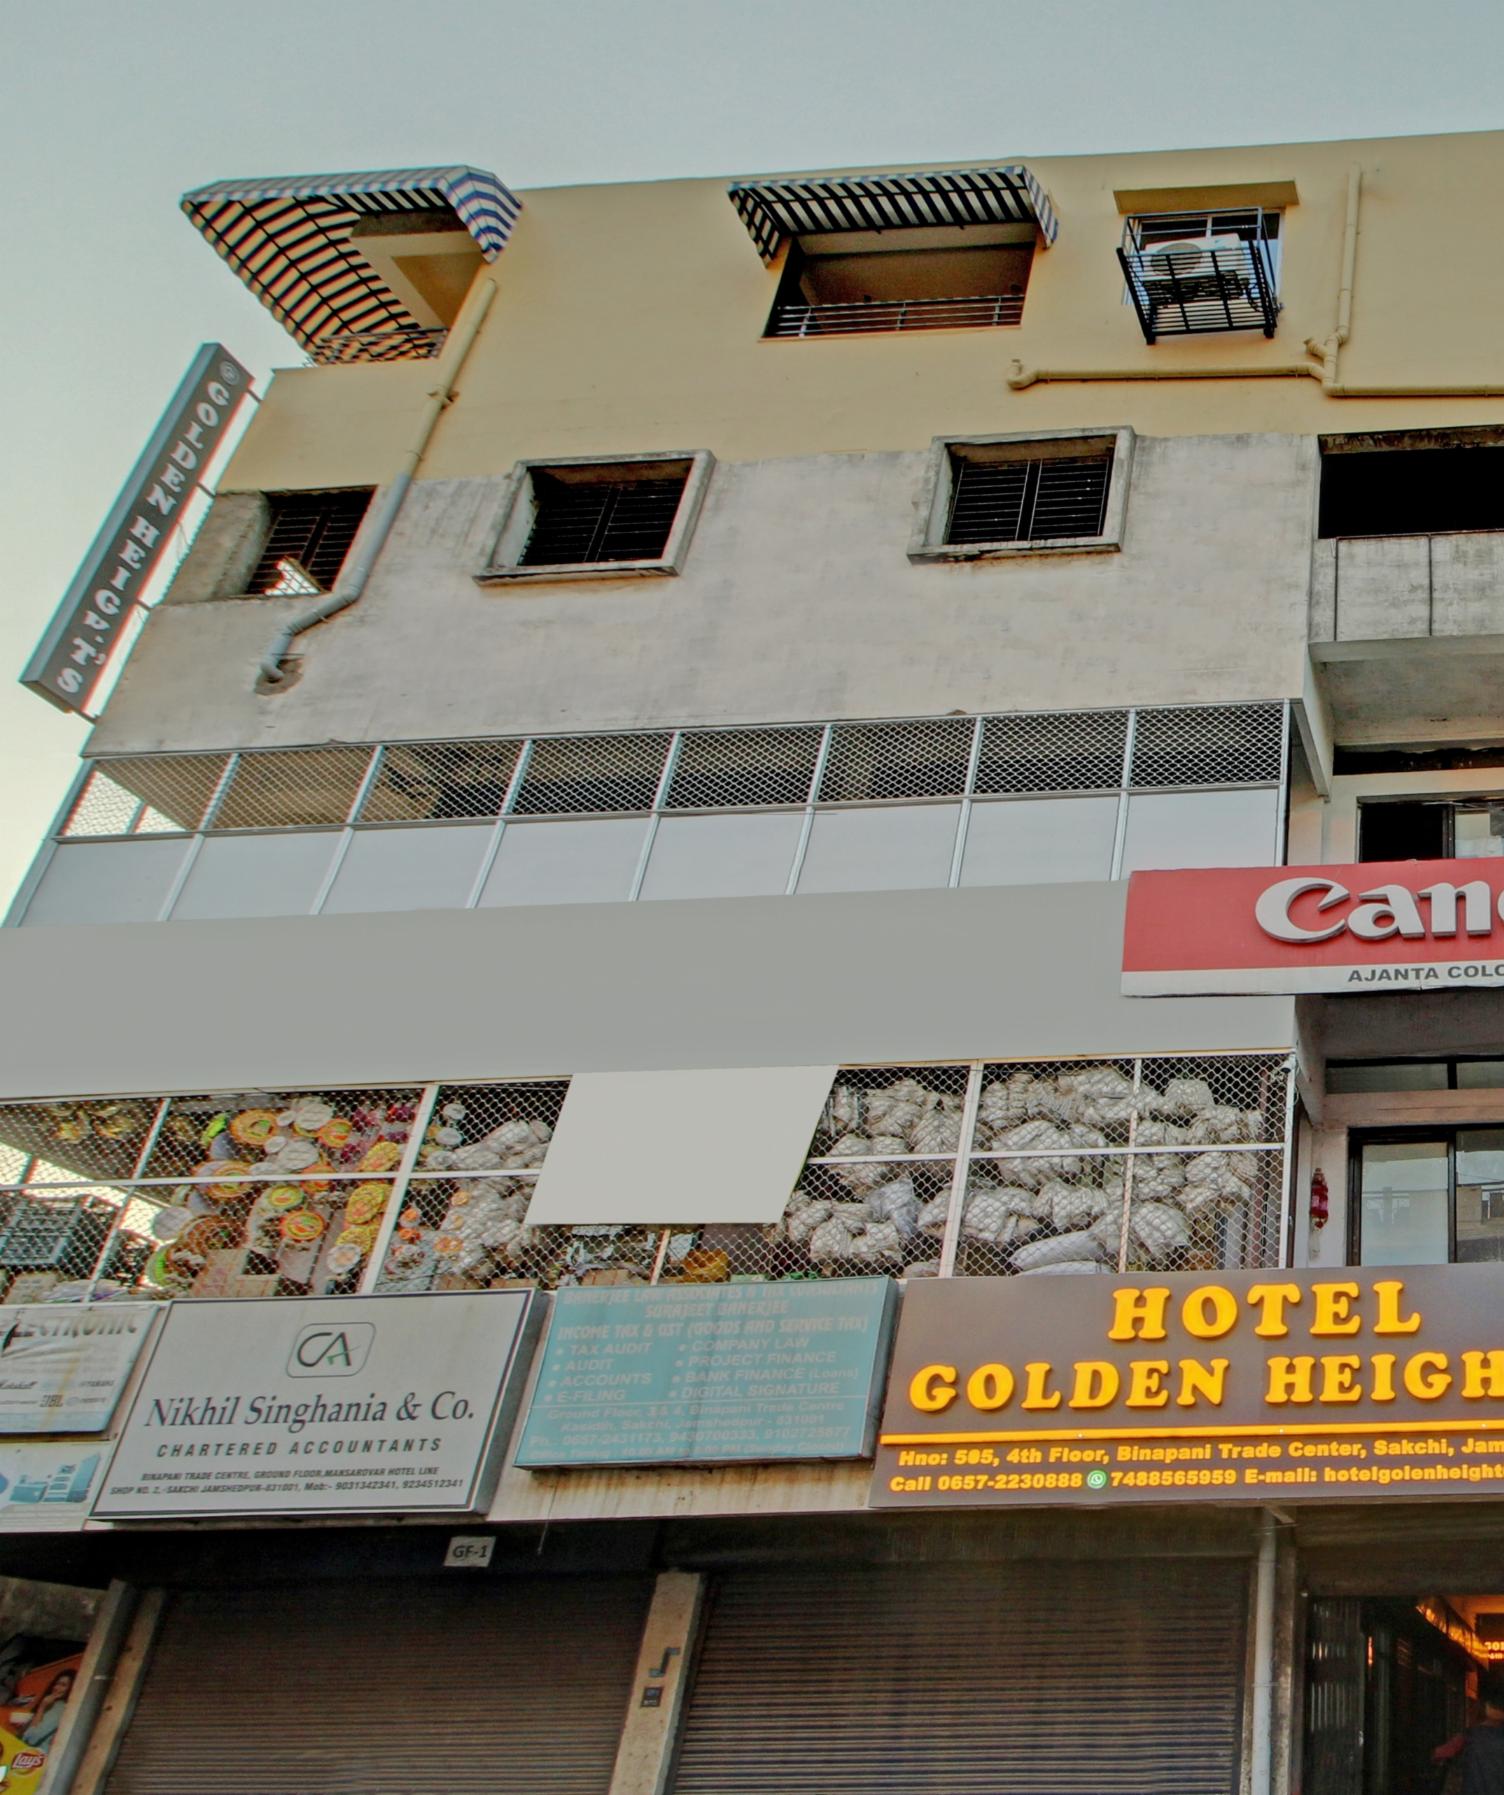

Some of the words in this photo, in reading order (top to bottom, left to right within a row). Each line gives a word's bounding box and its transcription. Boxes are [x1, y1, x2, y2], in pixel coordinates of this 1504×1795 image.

[145, 380, 230, 516] GOLDEN
[1347, 963, 1443, 983] AJANTA
[1106, 1280, 1422, 1342] HOTEL
[570, 1343, 600, 1357] TAX
[601, 1341, 654, 1355] AUDIT
[691, 1338, 771, 1352] COMPANY
[774, 1337, 811, 1350] LAW
[564, 1358, 616, 1371] AUDIT
[687, 1353, 765, 1368] PROJECT
[766, 1351, 839, 1365] FINANCE
[559, 1372, 654, 1387] ACCOUNTS
[684, 1369, 731, 1384] BANK
[734, 1366, 807, 1381] FINANCE
[681, 1385, 740, 1400] DIGITAL
[747, 1381, 841, 1397] SIGNATURE
[908, 1356, 1231, 1413] GOLDEN
[557, 1388, 627, 1402] E-FILING
[144, 1395, 243, 1427] Nikhil
[244, 1391, 387, 1434] Singhania
[395, 1391, 423, 1422] &
[430, 1390, 475, 1421] Co.
[156, 1441, 279, 1458] CHARTERED
[288, 1437, 441, 1455] ACCOUNTANTS
[898, 1449, 949, 1467] Hno:
[1006, 1448, 1042, 1464] 4th
[1048, 1446, 1110, 1465] Floor,
[1116, 1443, 1212, 1463] Binapani
[1218, 1440, 1281, 1460] Trade
[1287, 1440, 1368, 1459] Center,
[1373, 1437, 1455, 1457] Sakchi,
[184, 1470, 213, 1481] TRADE
[253, 1469, 291, 1479] GROUND
[387, 1467, 416, 1476] HOTEL
[418, 1466, 441, 1476] LINE
[889, 1475, 931, 1492] Call
[937, 1472, 1083, 1490] 0657-2230888
[1110, 1469, 1237, 1487] 7488565959
[1243, 1465, 1318, 1484] E-mail:
[452, 1543, 489, 1559] GF-1
